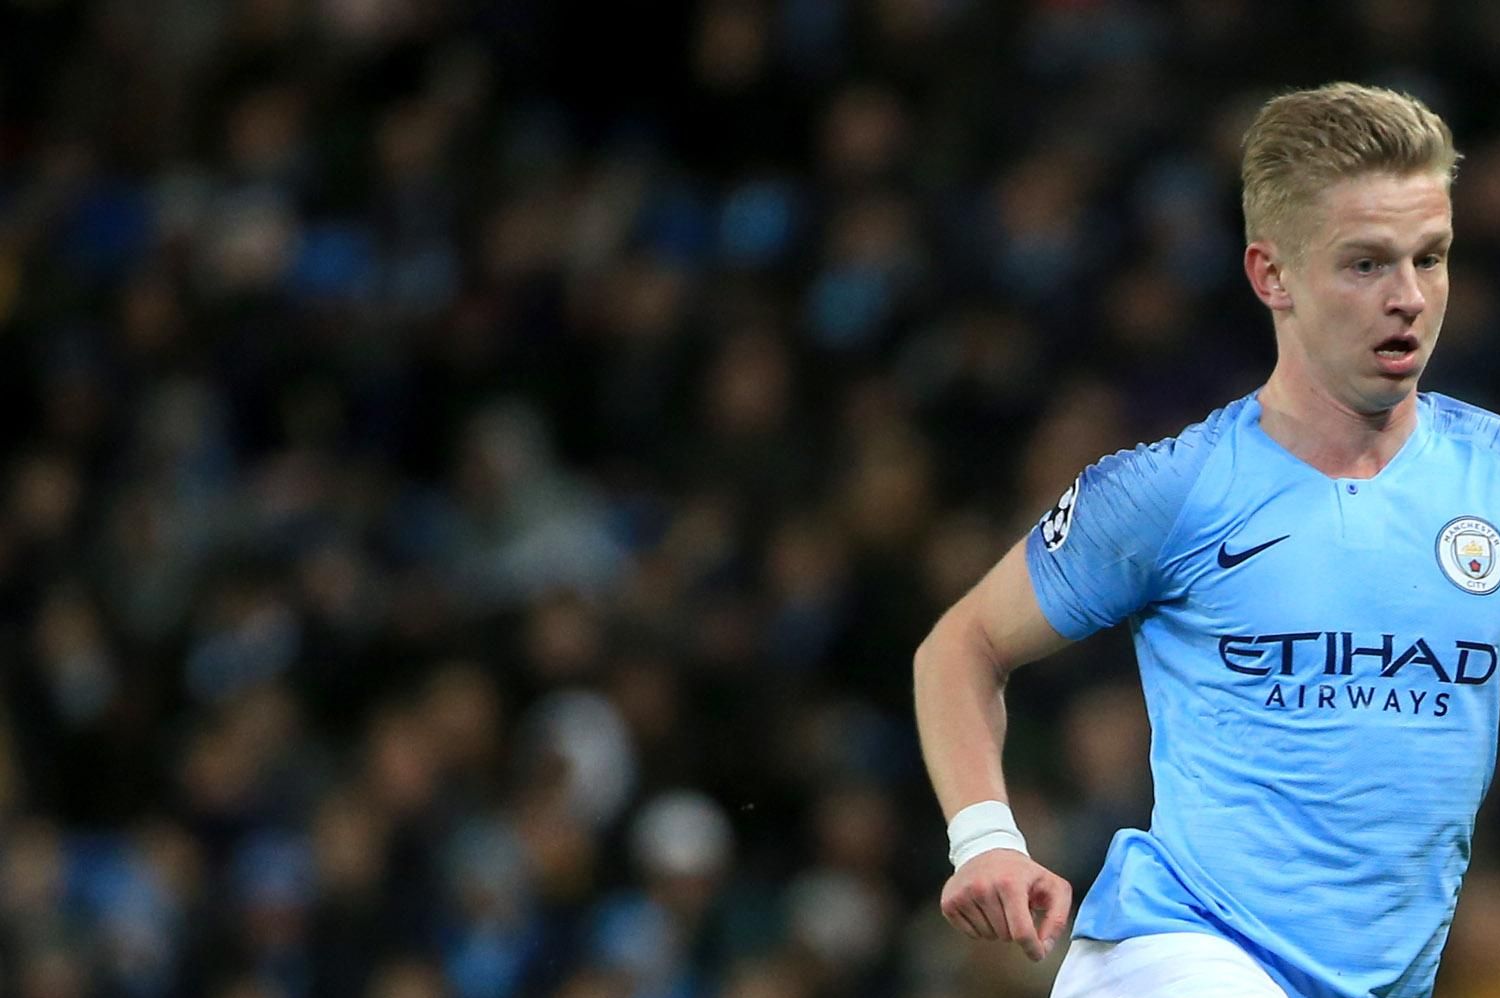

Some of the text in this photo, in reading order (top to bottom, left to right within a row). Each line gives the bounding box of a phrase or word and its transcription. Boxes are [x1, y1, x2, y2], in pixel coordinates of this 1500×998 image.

[1444, 522, 1500, 546] MANCHESTER
[1466, 580, 1487, 589] CITY
[1218, 631, 1498, 685] ETIHAD
[1265, 684, 1450, 717] AIRWAYS
